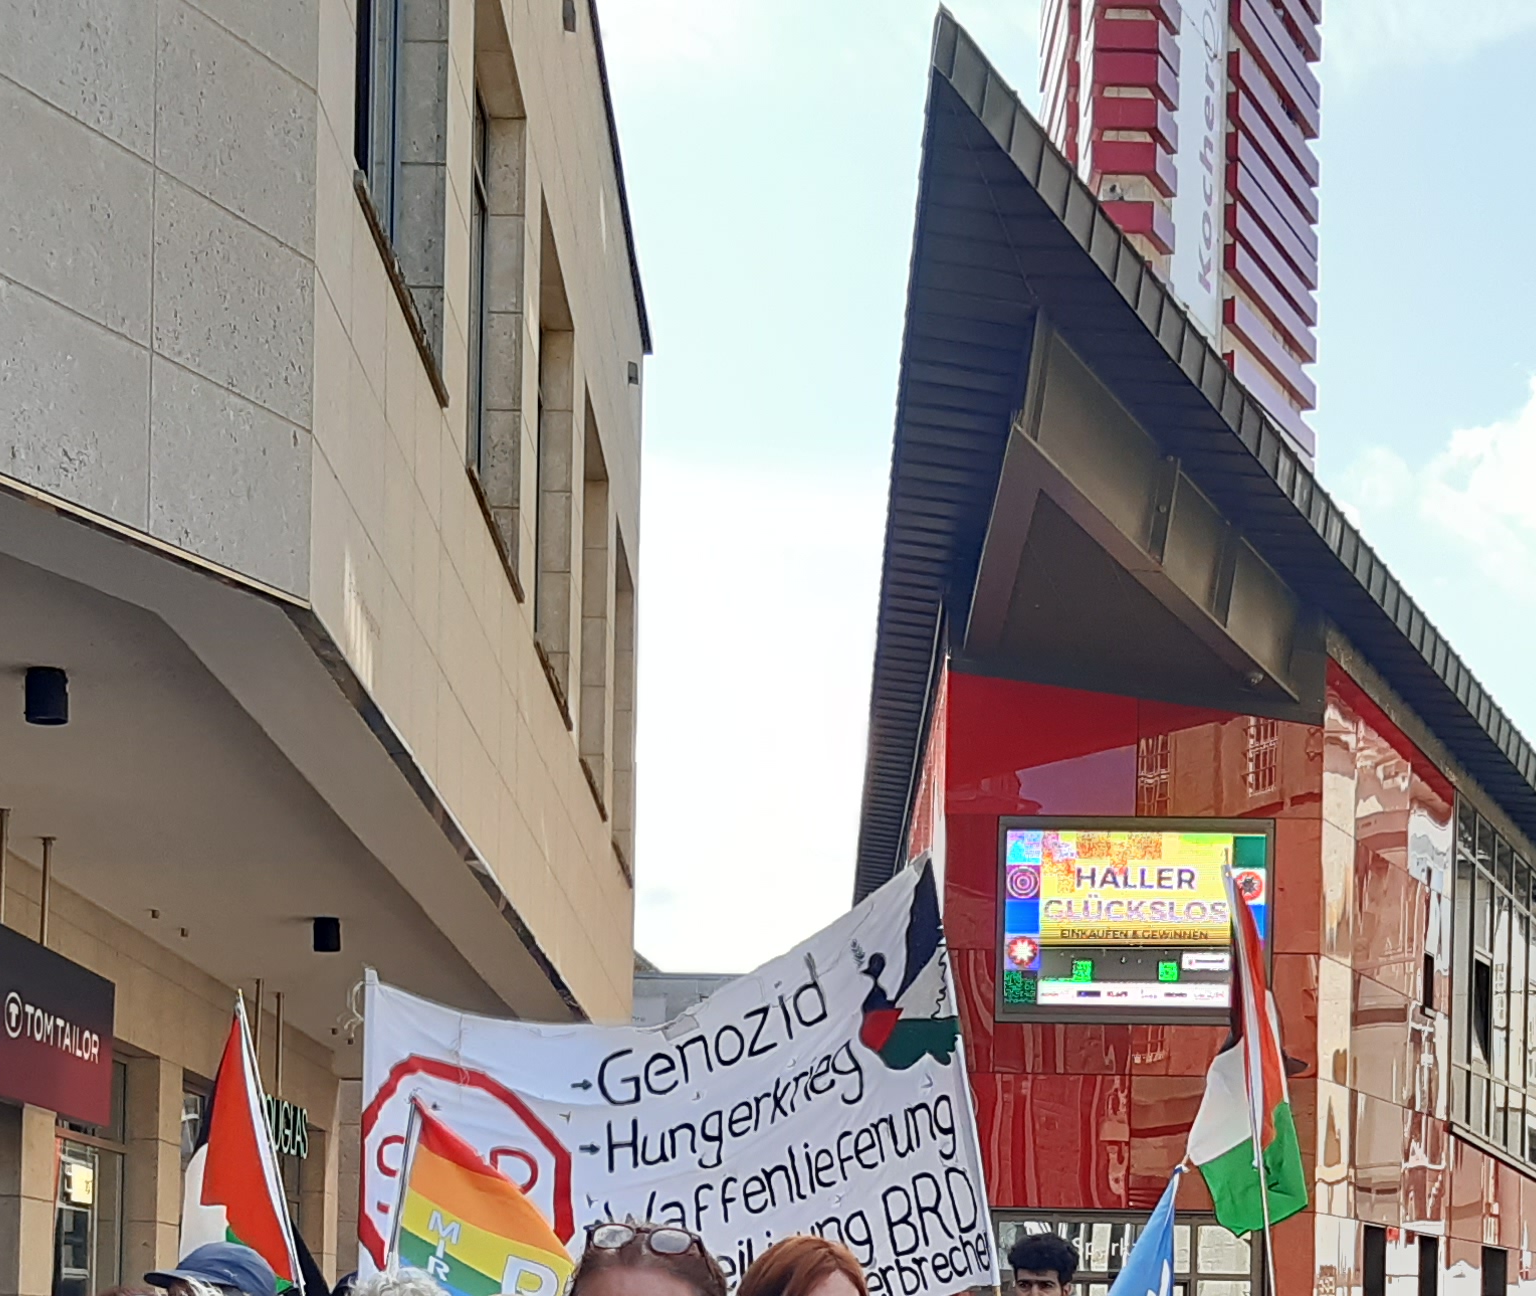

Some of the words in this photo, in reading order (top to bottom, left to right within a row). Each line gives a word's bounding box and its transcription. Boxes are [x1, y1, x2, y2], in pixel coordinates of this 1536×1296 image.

[1198, 0, 1221, 294] KocherQ
[1043, 894, 1228, 922] GLÜCKSLOS
[1076, 867, 1195, 889] HALLER
[1061, 929, 1128, 940] EINKAUFEN
[1142, 929, 1208, 940] GEWINNEN
[25, 1003, 55, 1046] TOM
[56, 1017, 100, 1064] TAILOR
[597, 953, 829, 1106] Genozid
[261, 1093, 309, 1159] OUGLAS
[606, 1039, 864, 1173] Hungerkrieg
[882, 1167, 978, 1257] BRD
